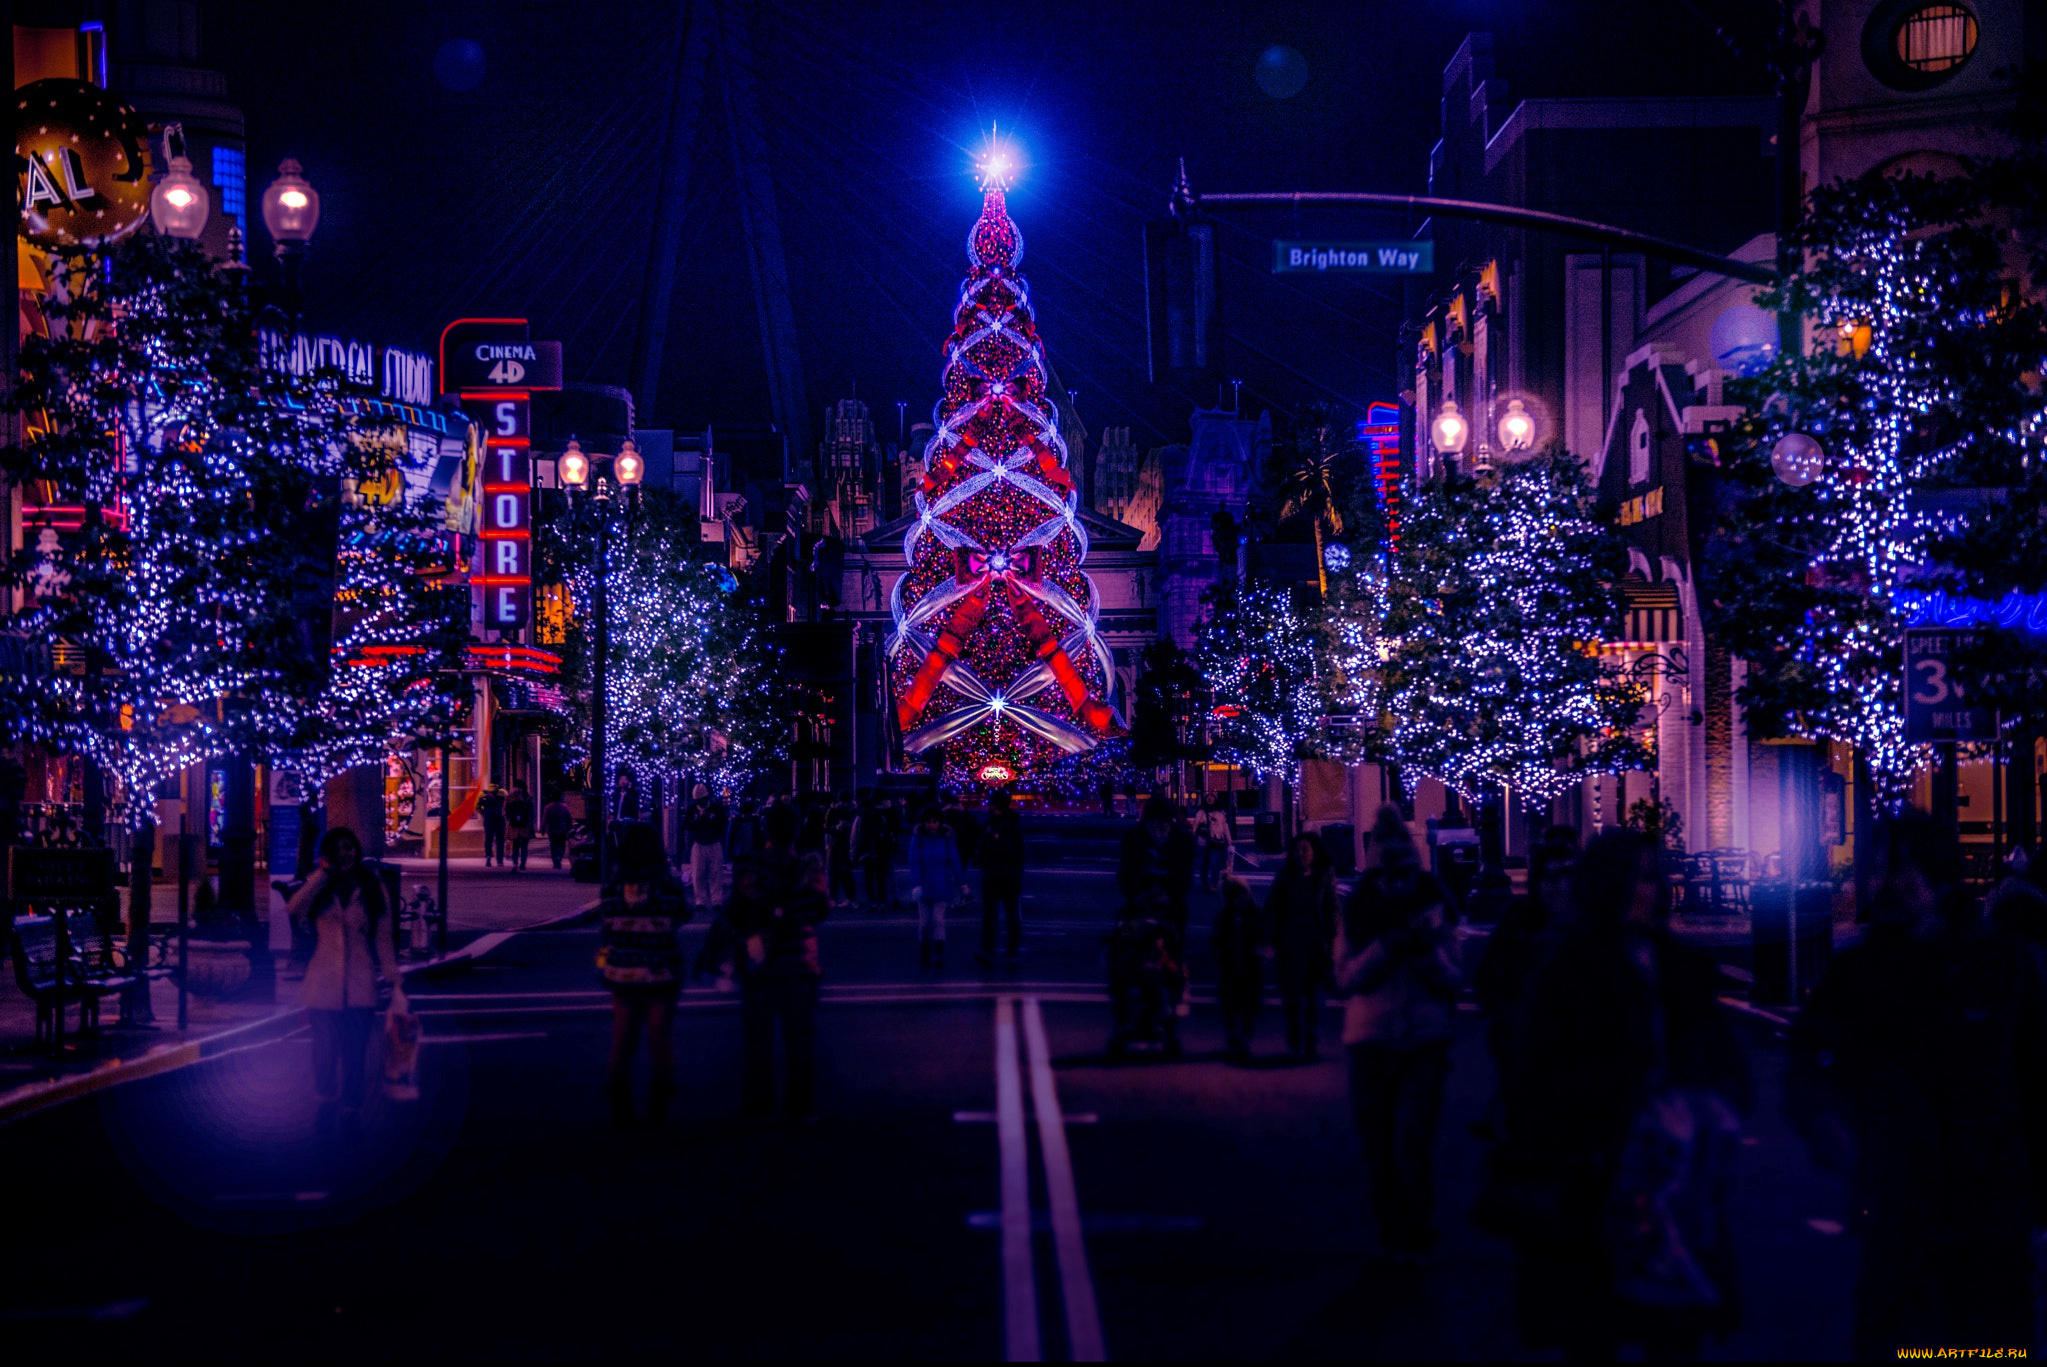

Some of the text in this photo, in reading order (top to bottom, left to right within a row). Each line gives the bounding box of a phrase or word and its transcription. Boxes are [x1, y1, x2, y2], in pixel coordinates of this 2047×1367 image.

[1289, 248, 1420, 271] Brighton Way
[475, 344, 537, 361] CINEMA
[496, 402, 518, 622] STORE
[1931, 710, 1972, 730] MILES
